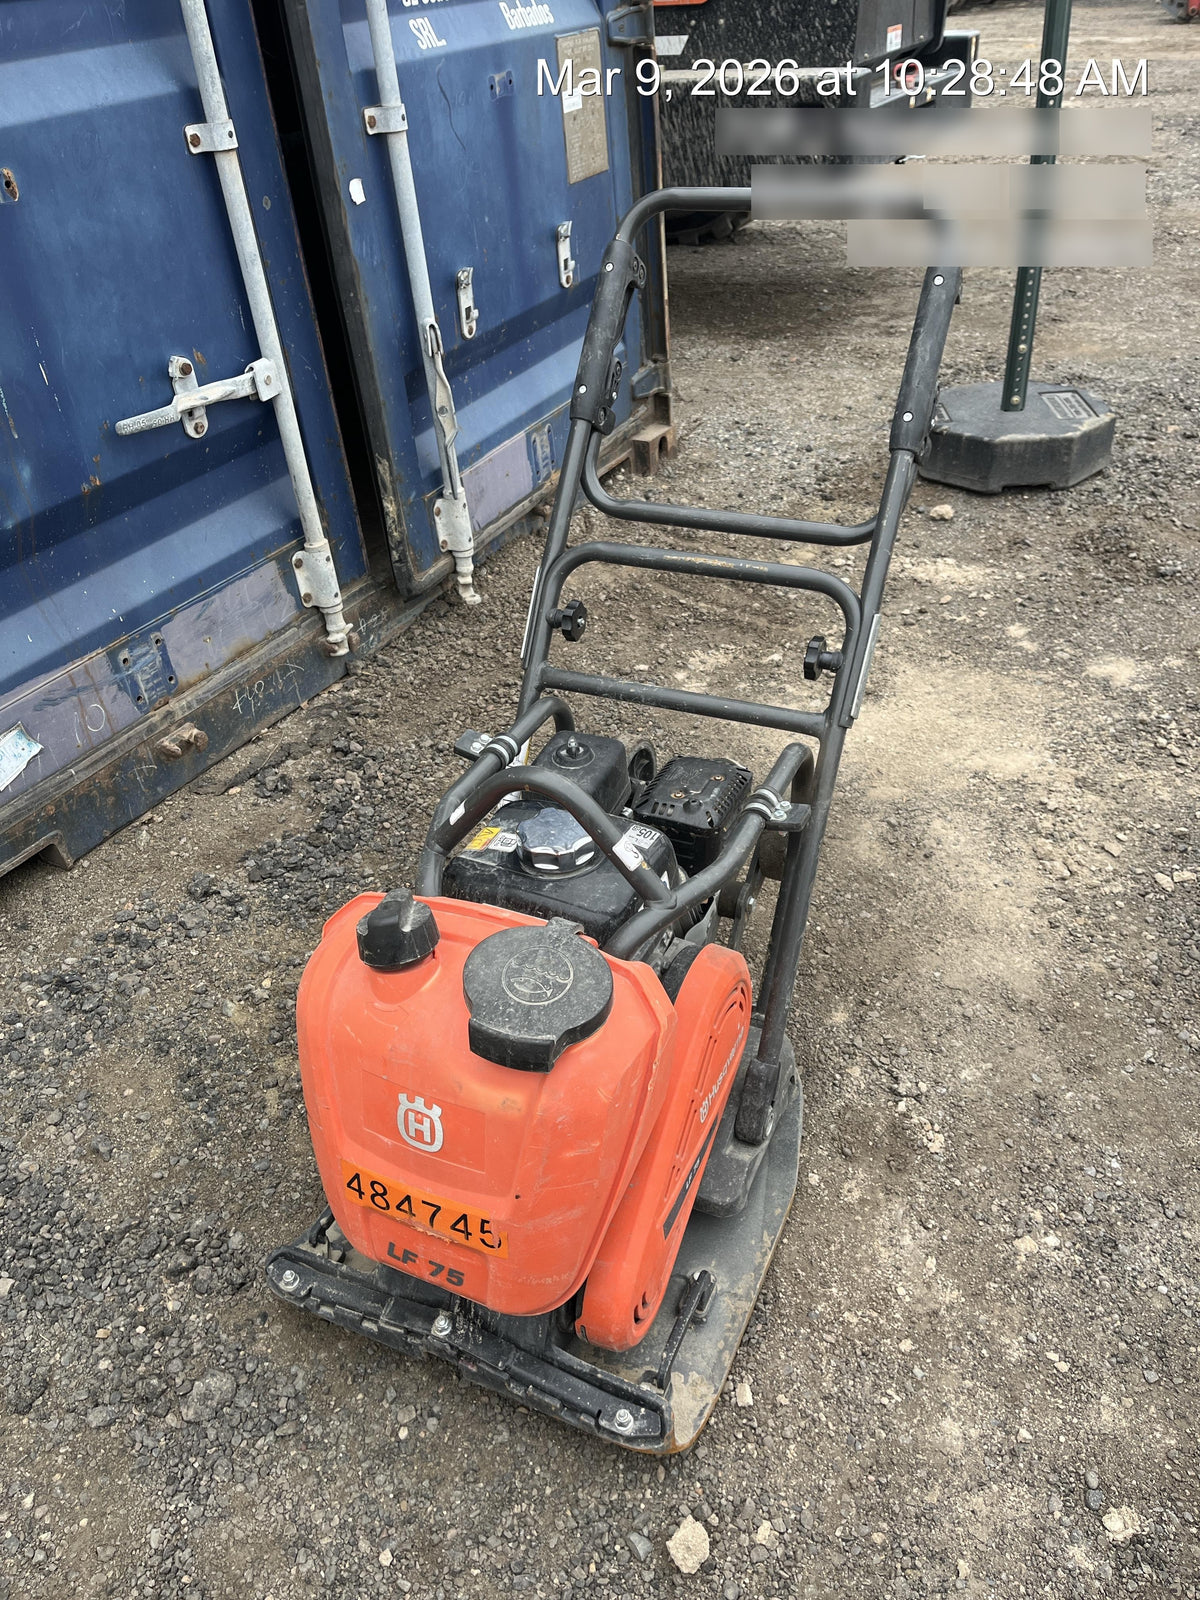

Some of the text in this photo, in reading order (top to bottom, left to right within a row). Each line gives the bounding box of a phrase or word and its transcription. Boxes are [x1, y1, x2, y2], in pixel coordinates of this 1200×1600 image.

[500, 2, 555, 30] Barbados
[636, 828, 658, 840] 105
[346, 1172, 502, 1250] 484745
[386, 1241, 465, 1287] LF 75
